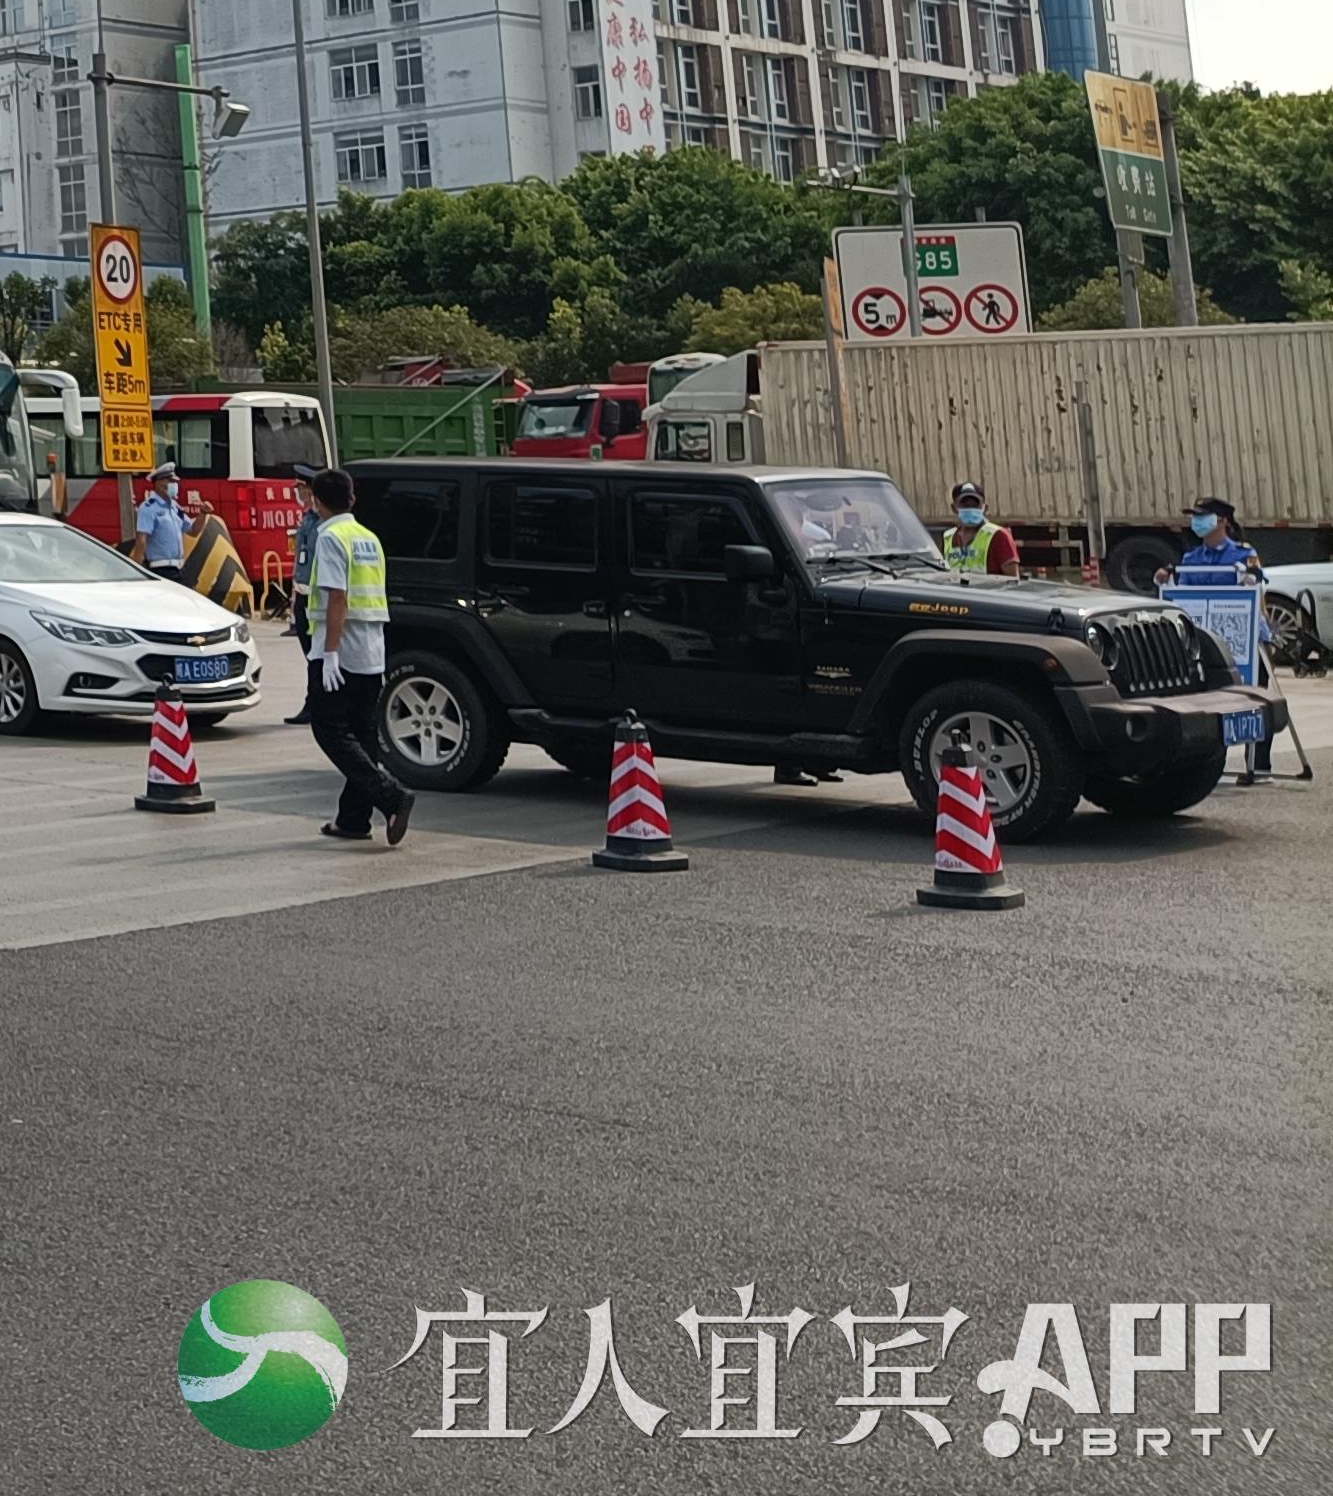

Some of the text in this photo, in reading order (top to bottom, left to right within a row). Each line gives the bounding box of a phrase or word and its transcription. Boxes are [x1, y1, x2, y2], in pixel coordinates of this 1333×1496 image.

[105, 254, 131, 285] 20
[98, 311, 143, 333] ETC专用
[103, 371, 146, 395] 车距5m
